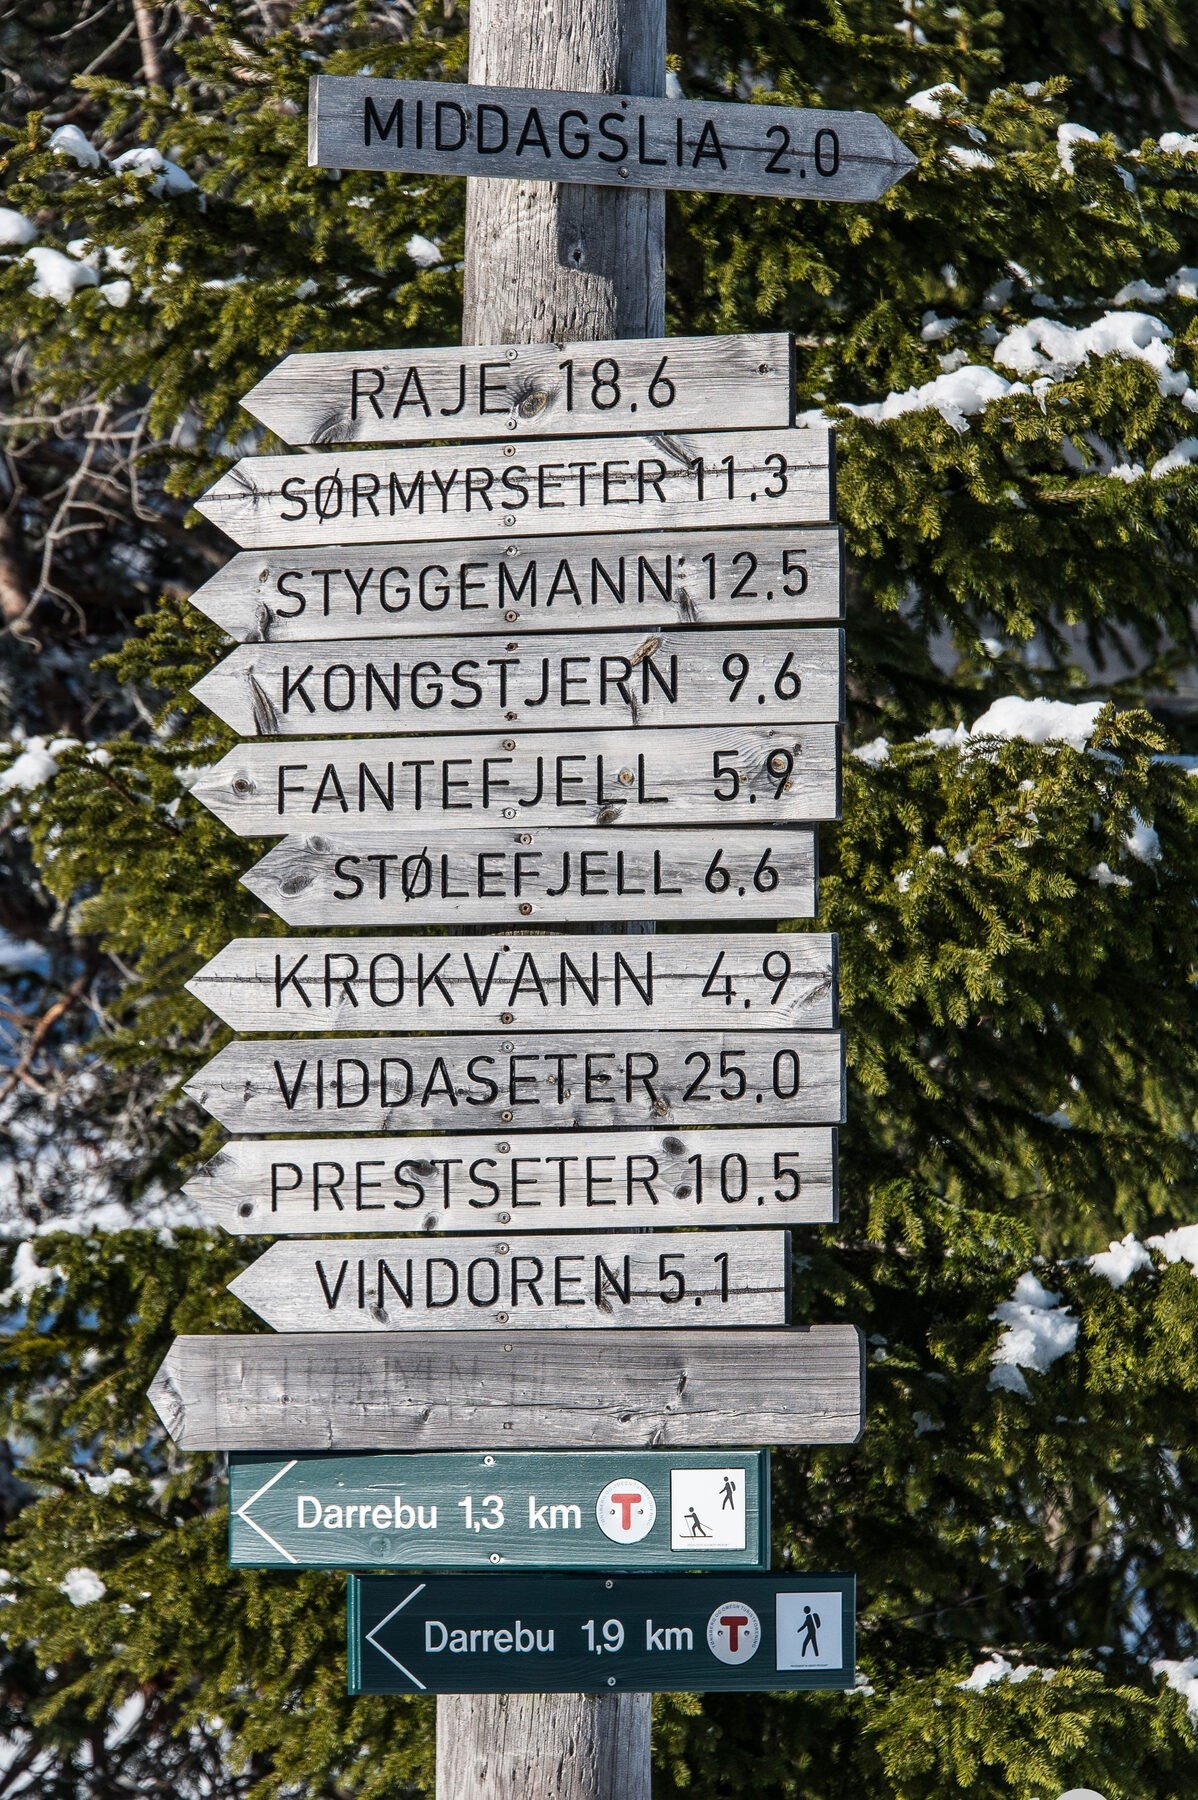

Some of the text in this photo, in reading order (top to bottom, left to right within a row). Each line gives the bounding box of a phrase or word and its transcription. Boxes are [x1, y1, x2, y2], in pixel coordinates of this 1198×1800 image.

[363, 96, 841, 178] MIDDAGSLIA 2.0
[350, 355, 677, 421] RAJE 18.6
[280, 452, 789, 524] SØRMYRSETER 11.3
[276, 548, 809, 619] STYGGEMANN 12.5
[281, 651, 802, 714] KONGSTJERN 9.6
[276, 748, 794, 815] FANTEFJELL 5.9
[333, 846, 779, 902] STØLEFJELL 6.6
[274, 950, 793, 1008] KROKVANN 4.9
[273, 1048, 801, 1110] VIDDASETER 25.0
[270, 1151, 802, 1213] PRESTSETER 10.5
[315, 1252, 731, 1311] VINDOREN 5.1
[297, 1496, 438, 1530] Darrebu
[457, 1496, 505, 1533] 1,3
[528, 1496, 582, 1529] km
[611, 1493, 642, 1531] T
[424, 1618, 694, 1655] Darrebu 1,9 km
[720, 1615, 749, 1652] T
